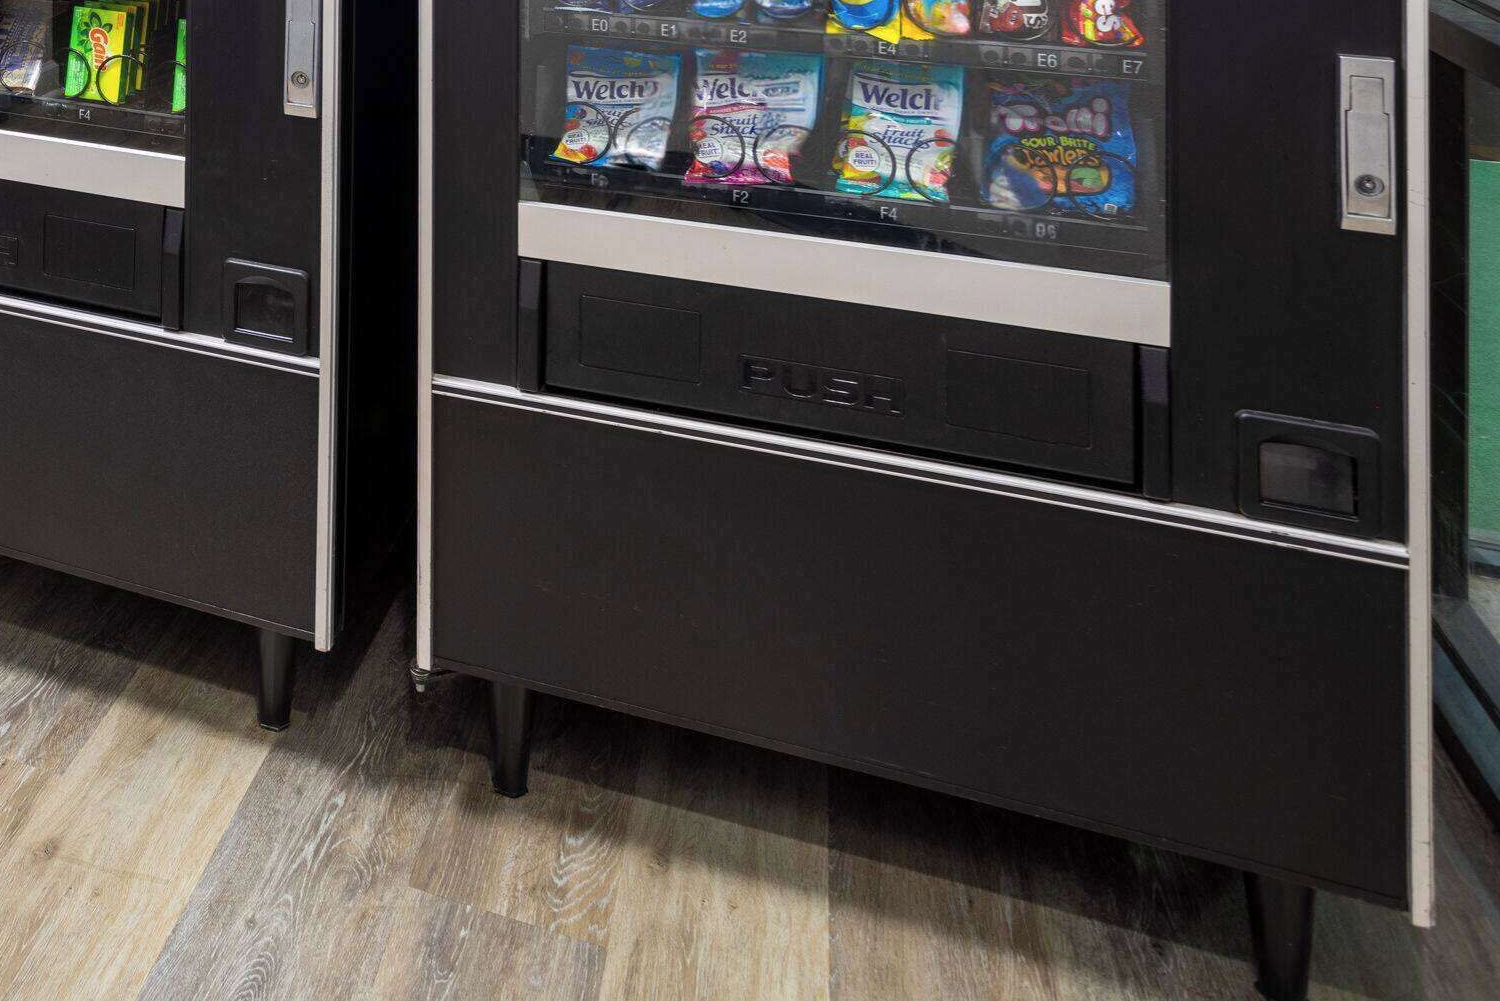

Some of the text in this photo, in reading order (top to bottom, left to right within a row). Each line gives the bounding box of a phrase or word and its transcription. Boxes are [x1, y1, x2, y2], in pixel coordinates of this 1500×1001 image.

[591, 18, 609, 32] E0
[660, 23, 677, 37] E1
[730, 30, 748, 44] E2
[878, 41, 897, 55] E4
[1036, 53, 1058, 68] E6
[1122, 59, 1144, 74] E7
[78, 109, 91, 121] F4
[883, 128, 925, 138] Fruit
[1020, 136, 1097, 150] SOUR BRITE
[855, 151, 873, 159] REAL
[732, 189, 749, 204] F2
[879, 206, 899, 218] F4
[739, 353, 907, 419] PUSH
